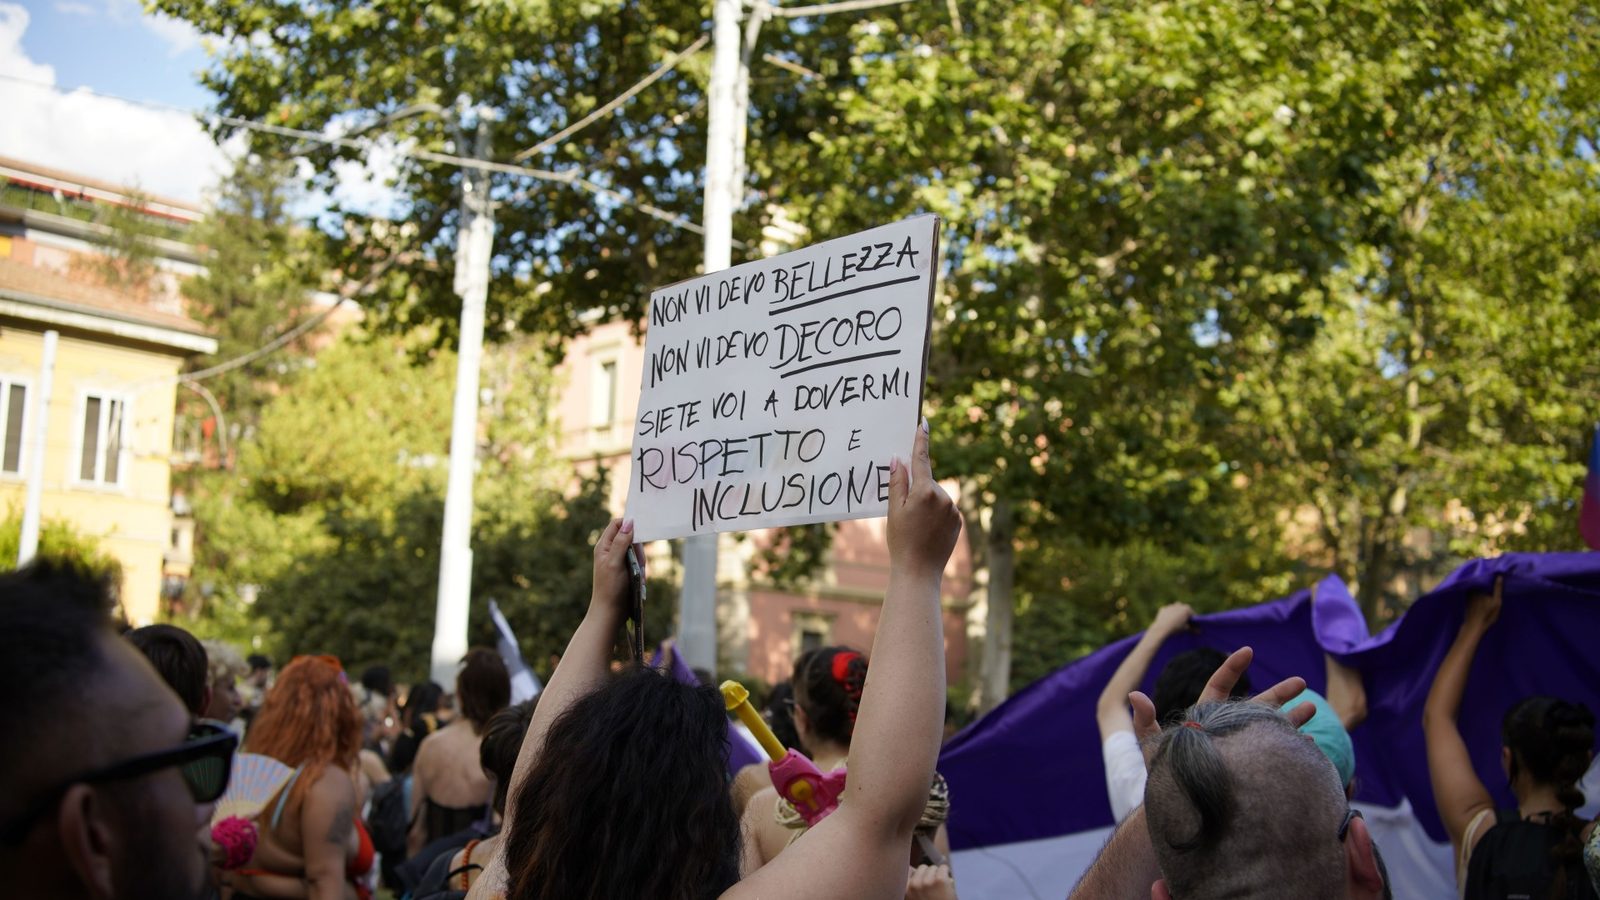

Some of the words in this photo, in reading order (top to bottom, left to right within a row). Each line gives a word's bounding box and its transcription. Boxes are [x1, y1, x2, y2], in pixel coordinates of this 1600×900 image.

[653, 289, 689, 328] NON
[696, 285, 711, 315] VI
[718, 271, 765, 311] DEVO
[769, 236, 920, 304] BELLEZZA
[651, 340, 690, 389] NON
[697, 337, 711, 370] VI
[715, 331, 769, 366] DEVO
[769, 306, 902, 369] DECORO
[639, 400, 701, 438] SIETE
[713, 390, 746, 420] VOI
[764, 389, 779, 418] A
[794, 367, 910, 412] DOVERMI
[637, 428, 826, 493] RISPETTO
[847, 429, 862, 451] E
[692, 461, 890, 532] INCLUSIONE
